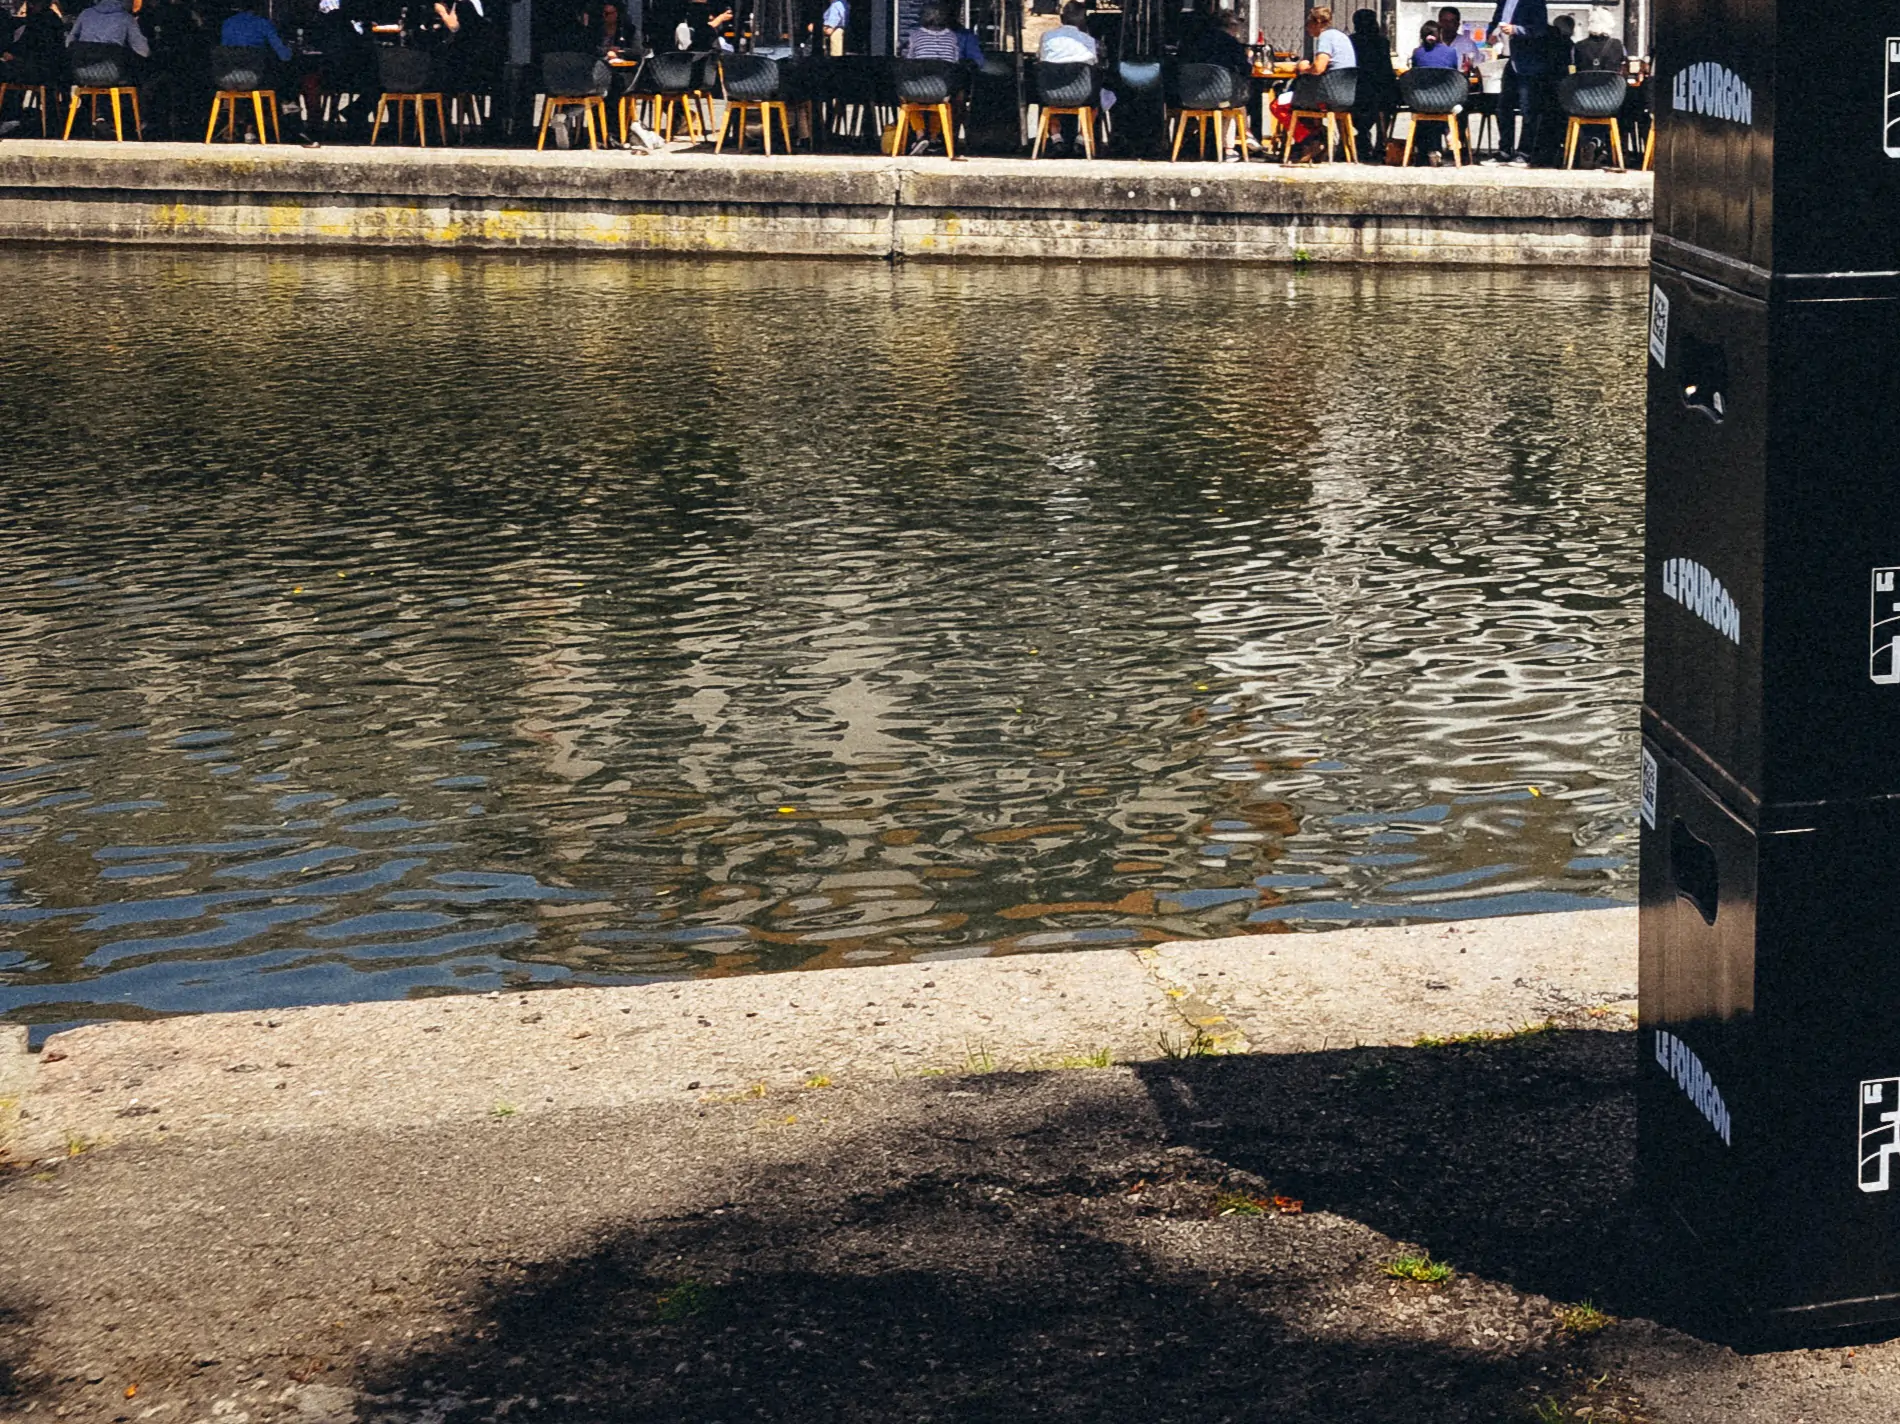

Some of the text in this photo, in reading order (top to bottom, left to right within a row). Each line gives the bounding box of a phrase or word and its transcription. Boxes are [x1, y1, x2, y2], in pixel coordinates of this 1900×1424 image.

[1672, 61, 1752, 125] LE FOURGON
[1662, 557, 1740, 645] LE FOURGON
[1655, 1029, 1731, 1147] LE FOURGON
